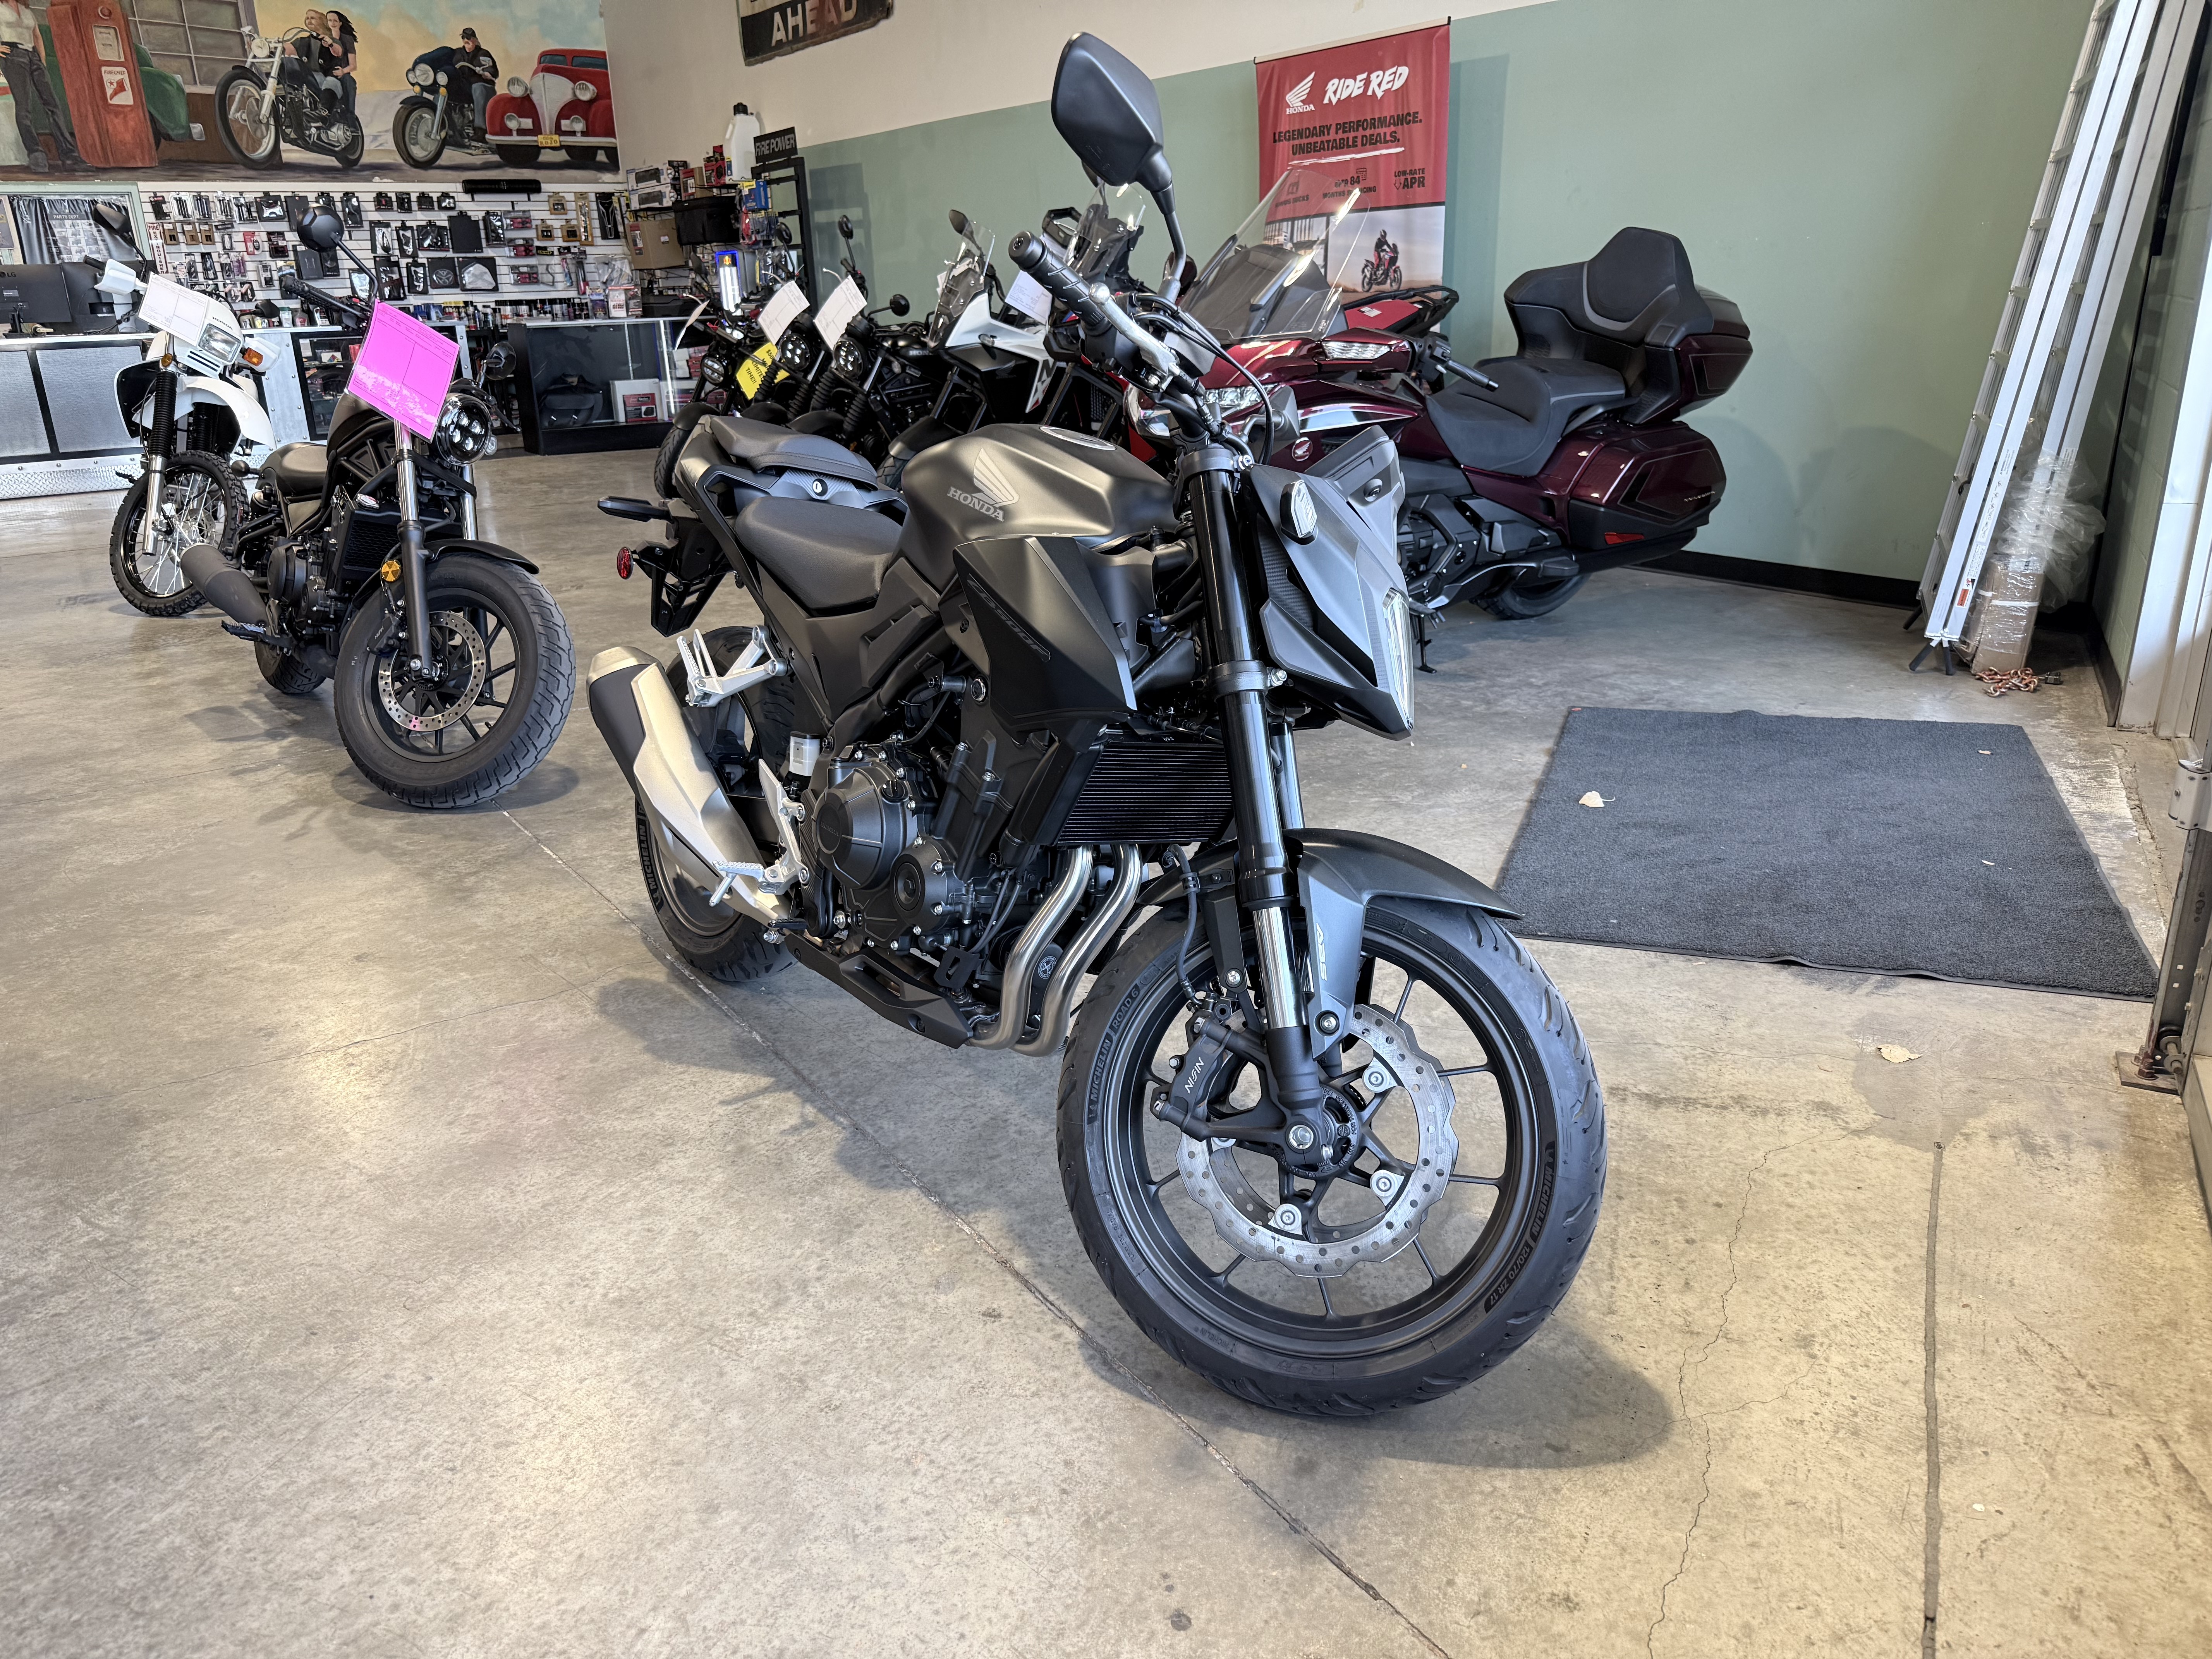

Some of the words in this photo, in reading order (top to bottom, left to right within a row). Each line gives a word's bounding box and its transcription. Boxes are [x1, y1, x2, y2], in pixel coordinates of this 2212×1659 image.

[771, 0, 857, 46] AHEAD
[1323, 72, 1368, 105] RIDE
[1367, 65, 1409, 100] RED
[1286, 104, 1315, 115] HONDA
[1273, 124, 1332, 143] LEGENDARY
[1335, 111, 1422, 135] PERFORMANCE.
[1292, 136, 1358, 156] UNBEATABLE
[1360, 131, 1400, 147] DEALS.
[1350, 175, 1360, 185] 84
[1394, 168, 1425, 177] LOW-RATE
[1402, 176, 1425, 190] APR
[1322, 190, 1346, 199] MONTHS
[212, 316, 234, 331] HONDA
[947, 486, 1004, 522] HONDA
[639, 825, 657, 890] MICHELIN
[1316, 922, 1328, 981] ABS
[1112, 997, 1132, 1029] ROAD
[1131, 988, 1139, 997] 6
[1091, 1039, 1111, 1102] MICHELIN
[1531, 1165, 1553, 1236] MICHELIN
[1508, 1246, 1530, 1279] 120/70
[1490, 1293, 1498, 1307] 17
[1498, 1281, 1509, 1294] ZR
